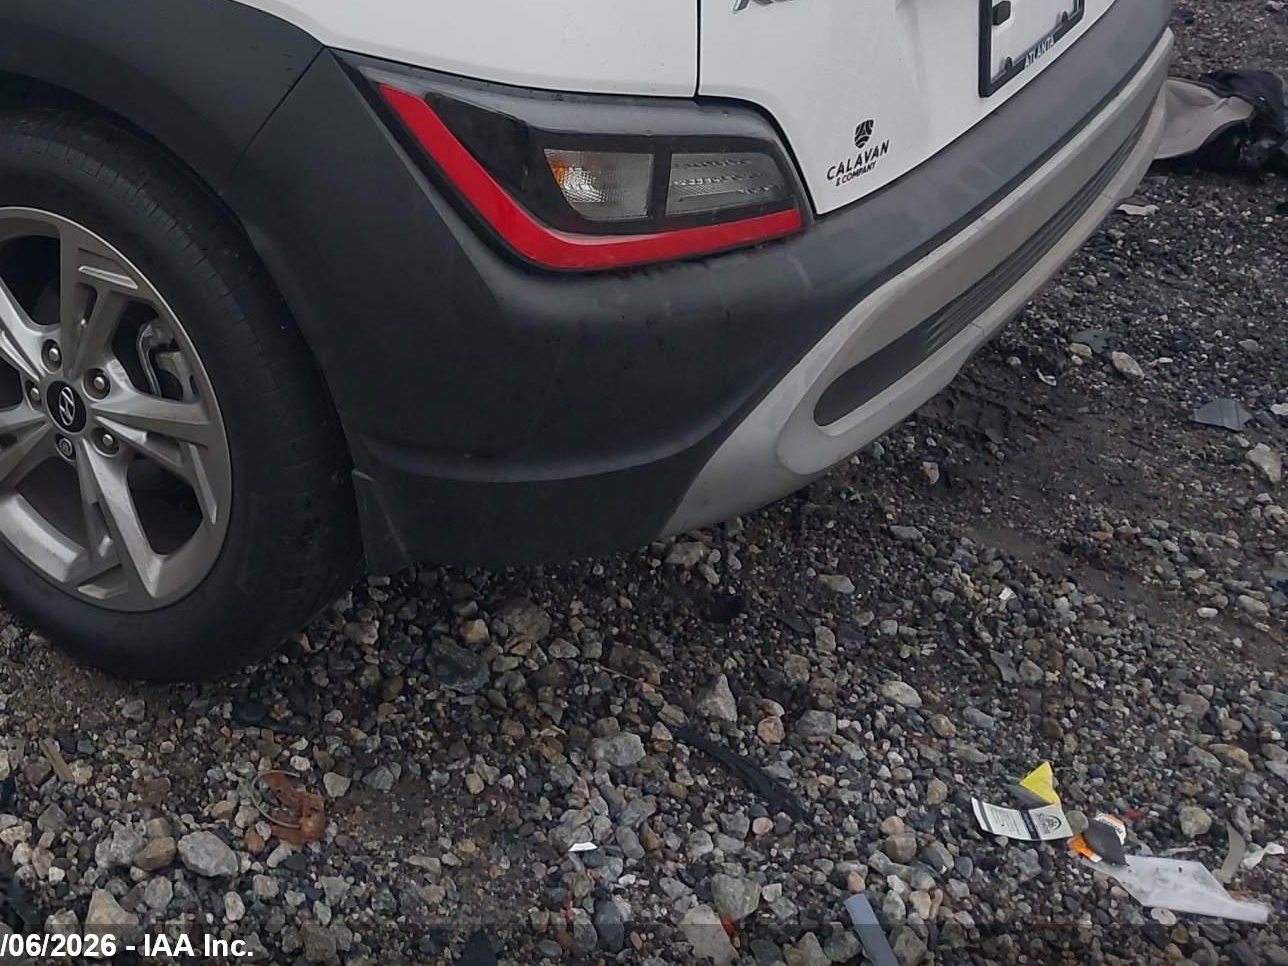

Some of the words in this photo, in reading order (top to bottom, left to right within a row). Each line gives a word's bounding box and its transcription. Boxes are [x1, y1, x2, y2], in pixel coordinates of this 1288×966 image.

[1024, 35, 1055, 69] ATLANTA
[826, 139, 890, 181] CALAVAN
[841, 161, 877, 184] COMPANY
